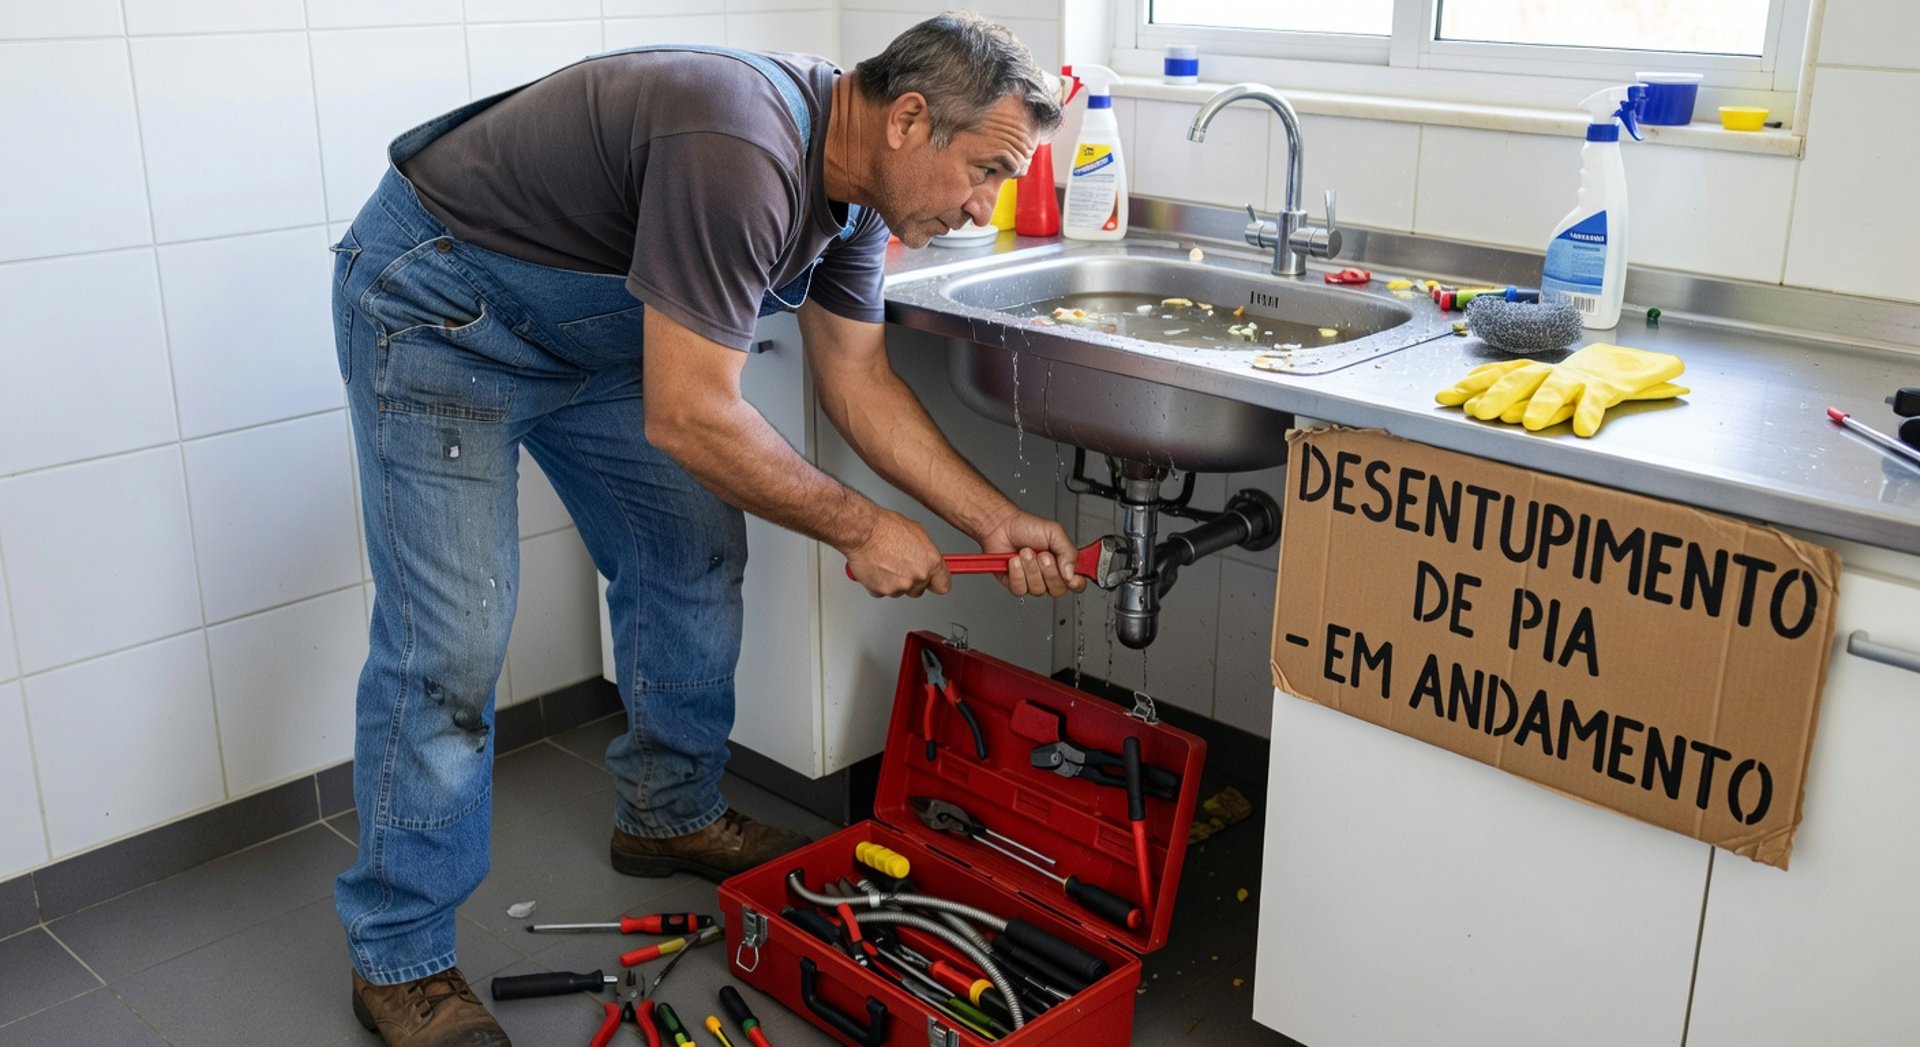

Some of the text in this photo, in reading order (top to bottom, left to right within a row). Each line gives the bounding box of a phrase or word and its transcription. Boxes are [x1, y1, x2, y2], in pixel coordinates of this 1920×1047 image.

[1298, 441, 1819, 641] DESENTUPIMENTO
[1412, 559, 1601, 678] DE PIA
[1285, 622, 1775, 827] - EM ANDAMENTO
